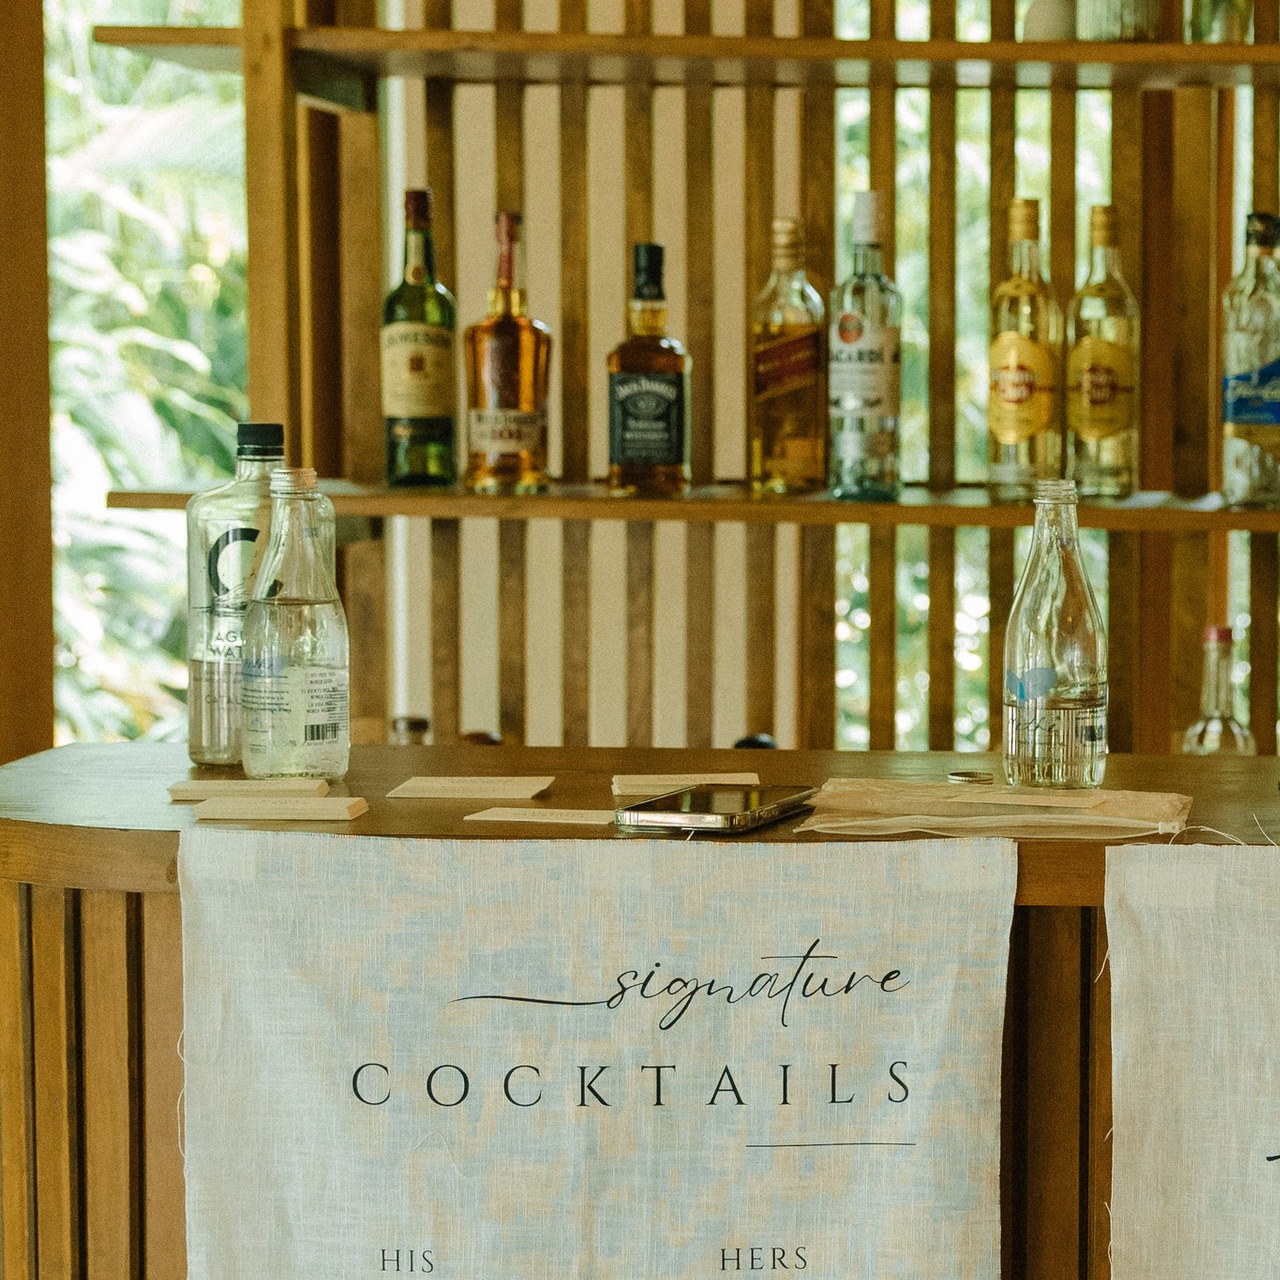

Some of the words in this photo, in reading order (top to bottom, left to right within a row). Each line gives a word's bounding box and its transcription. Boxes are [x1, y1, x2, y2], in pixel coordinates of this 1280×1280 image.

[447, 938, 910, 1031] signature
[351, 1060, 909, 1108] COCKTAILS
[380, 1248, 434, 1274] HIS
[720, 1246, 808, 1272] HERS
